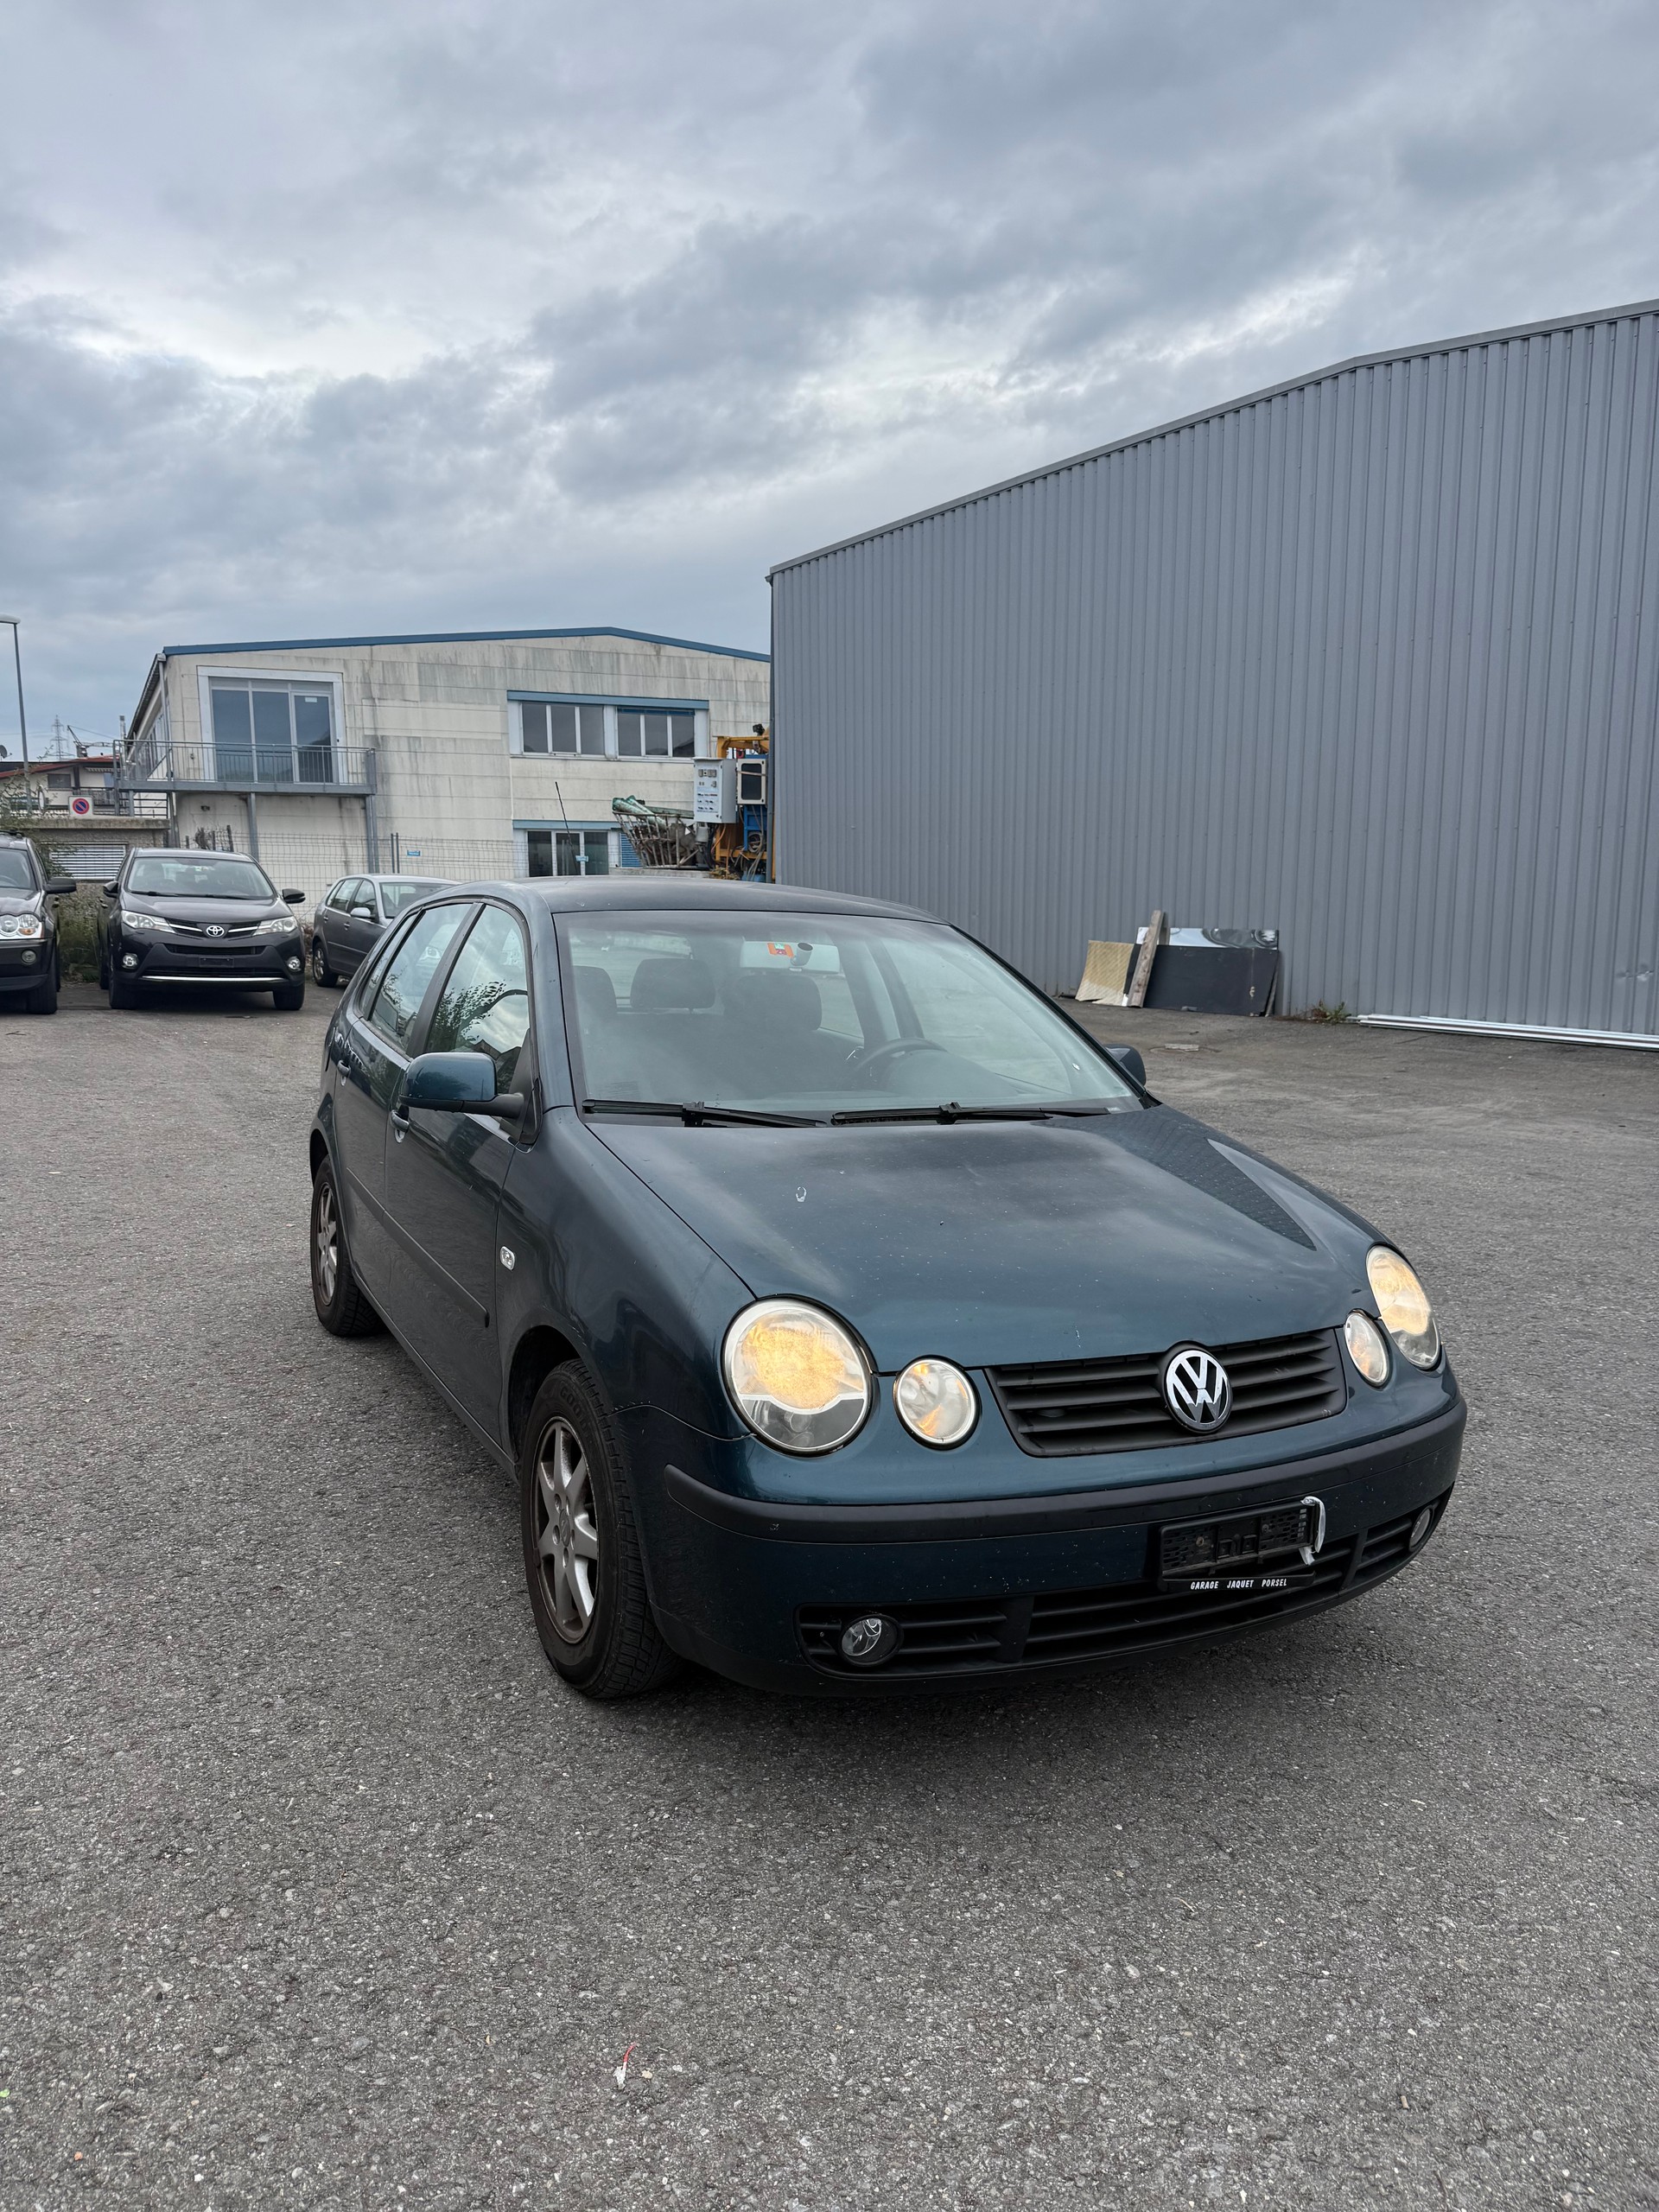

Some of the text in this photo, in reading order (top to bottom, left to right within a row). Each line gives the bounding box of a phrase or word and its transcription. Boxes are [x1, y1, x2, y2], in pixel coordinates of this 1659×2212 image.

[1166, 1350, 1232, 1431] VW
[1190, 1579, 1287, 1590] GARAGE JAQUET PORSEL
